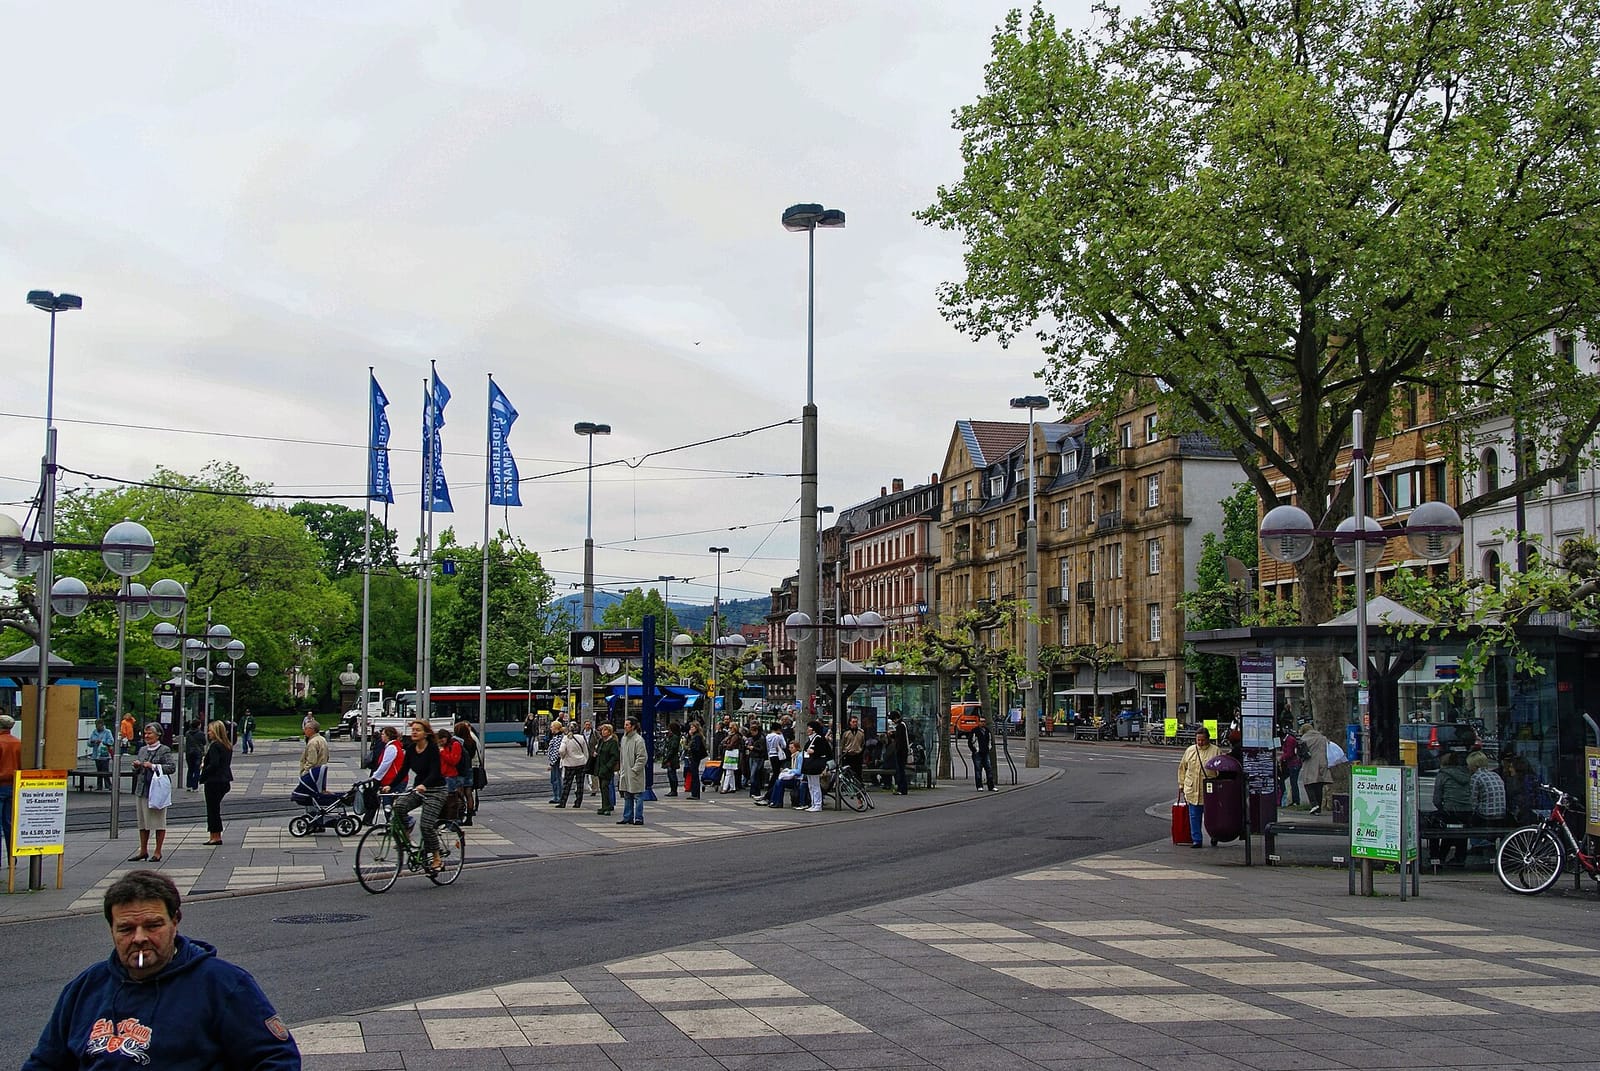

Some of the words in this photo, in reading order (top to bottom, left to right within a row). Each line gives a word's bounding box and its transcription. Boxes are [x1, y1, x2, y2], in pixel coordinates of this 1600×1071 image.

[1367, 782, 1384, 790] Jahre
[1385, 783, 1397, 792] GAL
[1366, 828, 1377, 838] Mai
